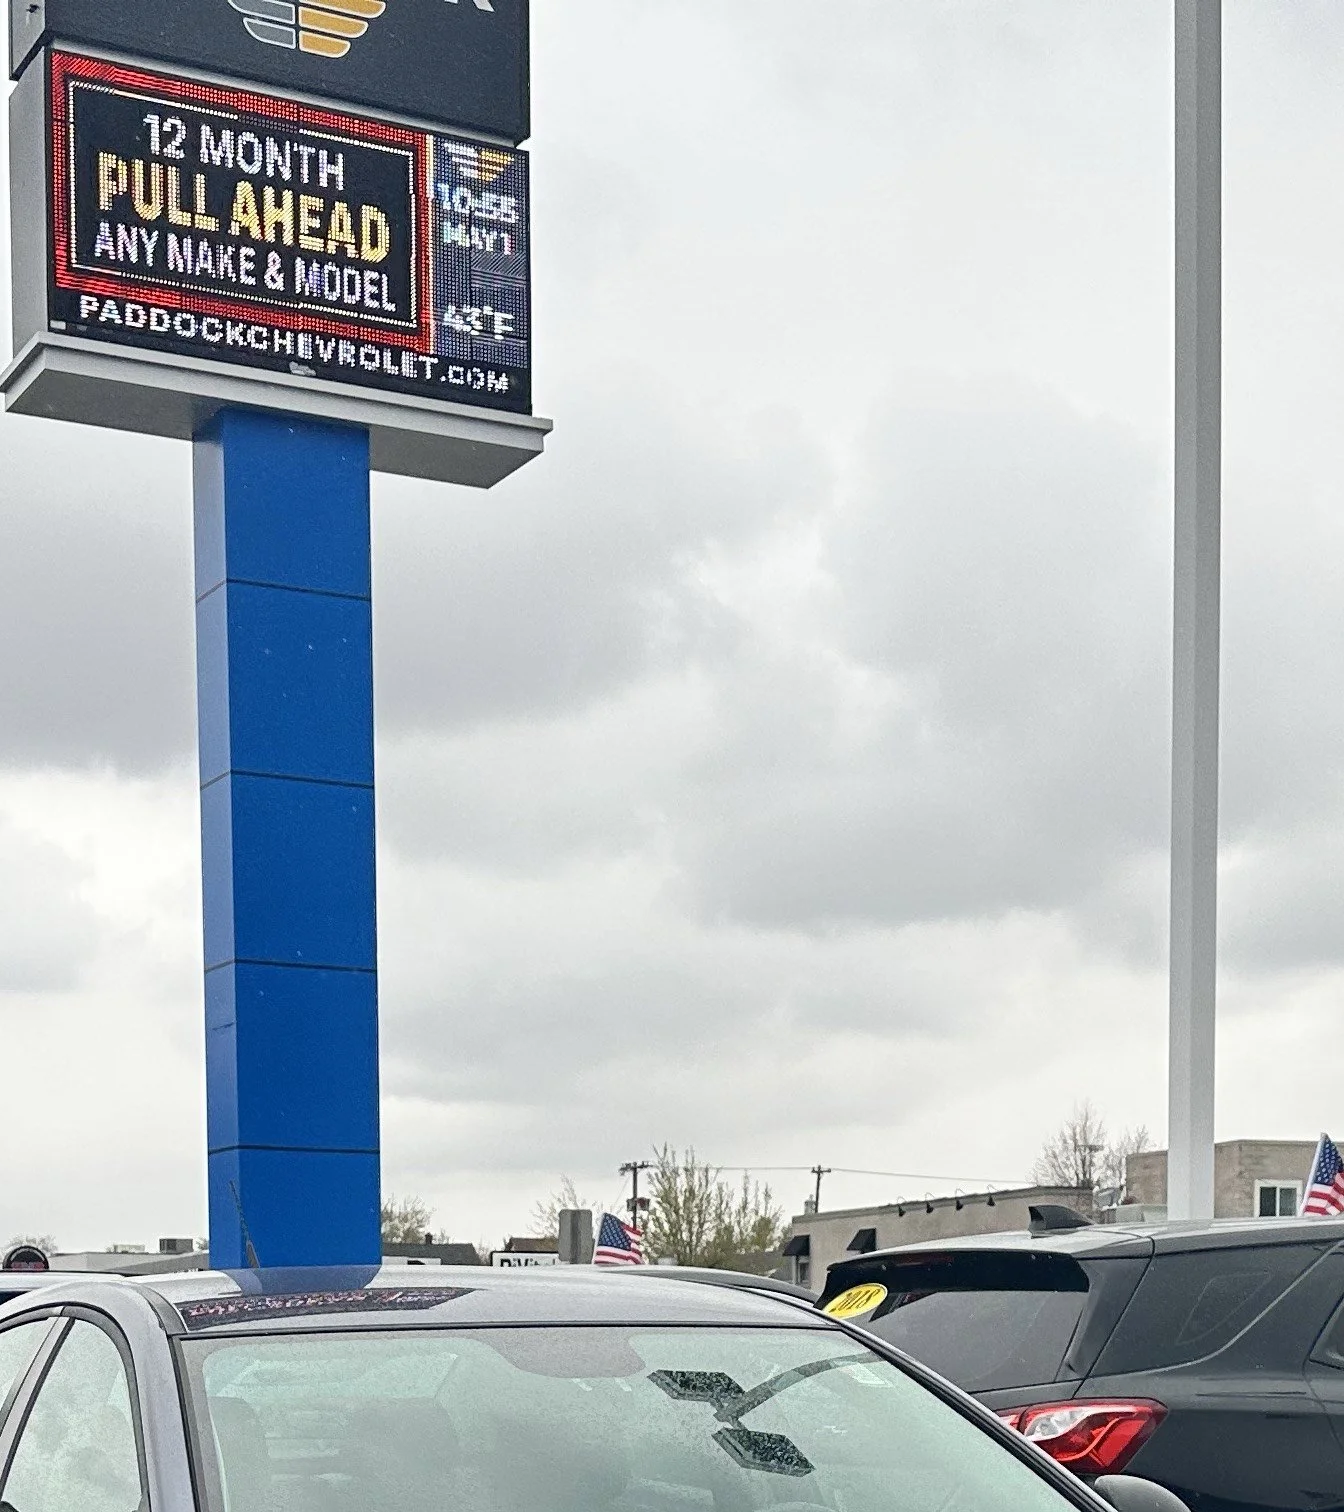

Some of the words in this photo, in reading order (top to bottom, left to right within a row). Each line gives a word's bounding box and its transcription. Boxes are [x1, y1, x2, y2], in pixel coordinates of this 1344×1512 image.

[143, 114, 186, 159] 12
[200, 124, 344, 190] MONTH
[98, 152, 219, 231] PULL
[228, 180, 390, 263] AHEAD
[94, 219, 159, 267] ANY
[167, 233, 257, 285] MAKE
[264, 251, 285, 291] &
[294, 257, 397, 312] MODEL
[79, 295, 510, 393] PADDOCKCHEVROLET.COM
